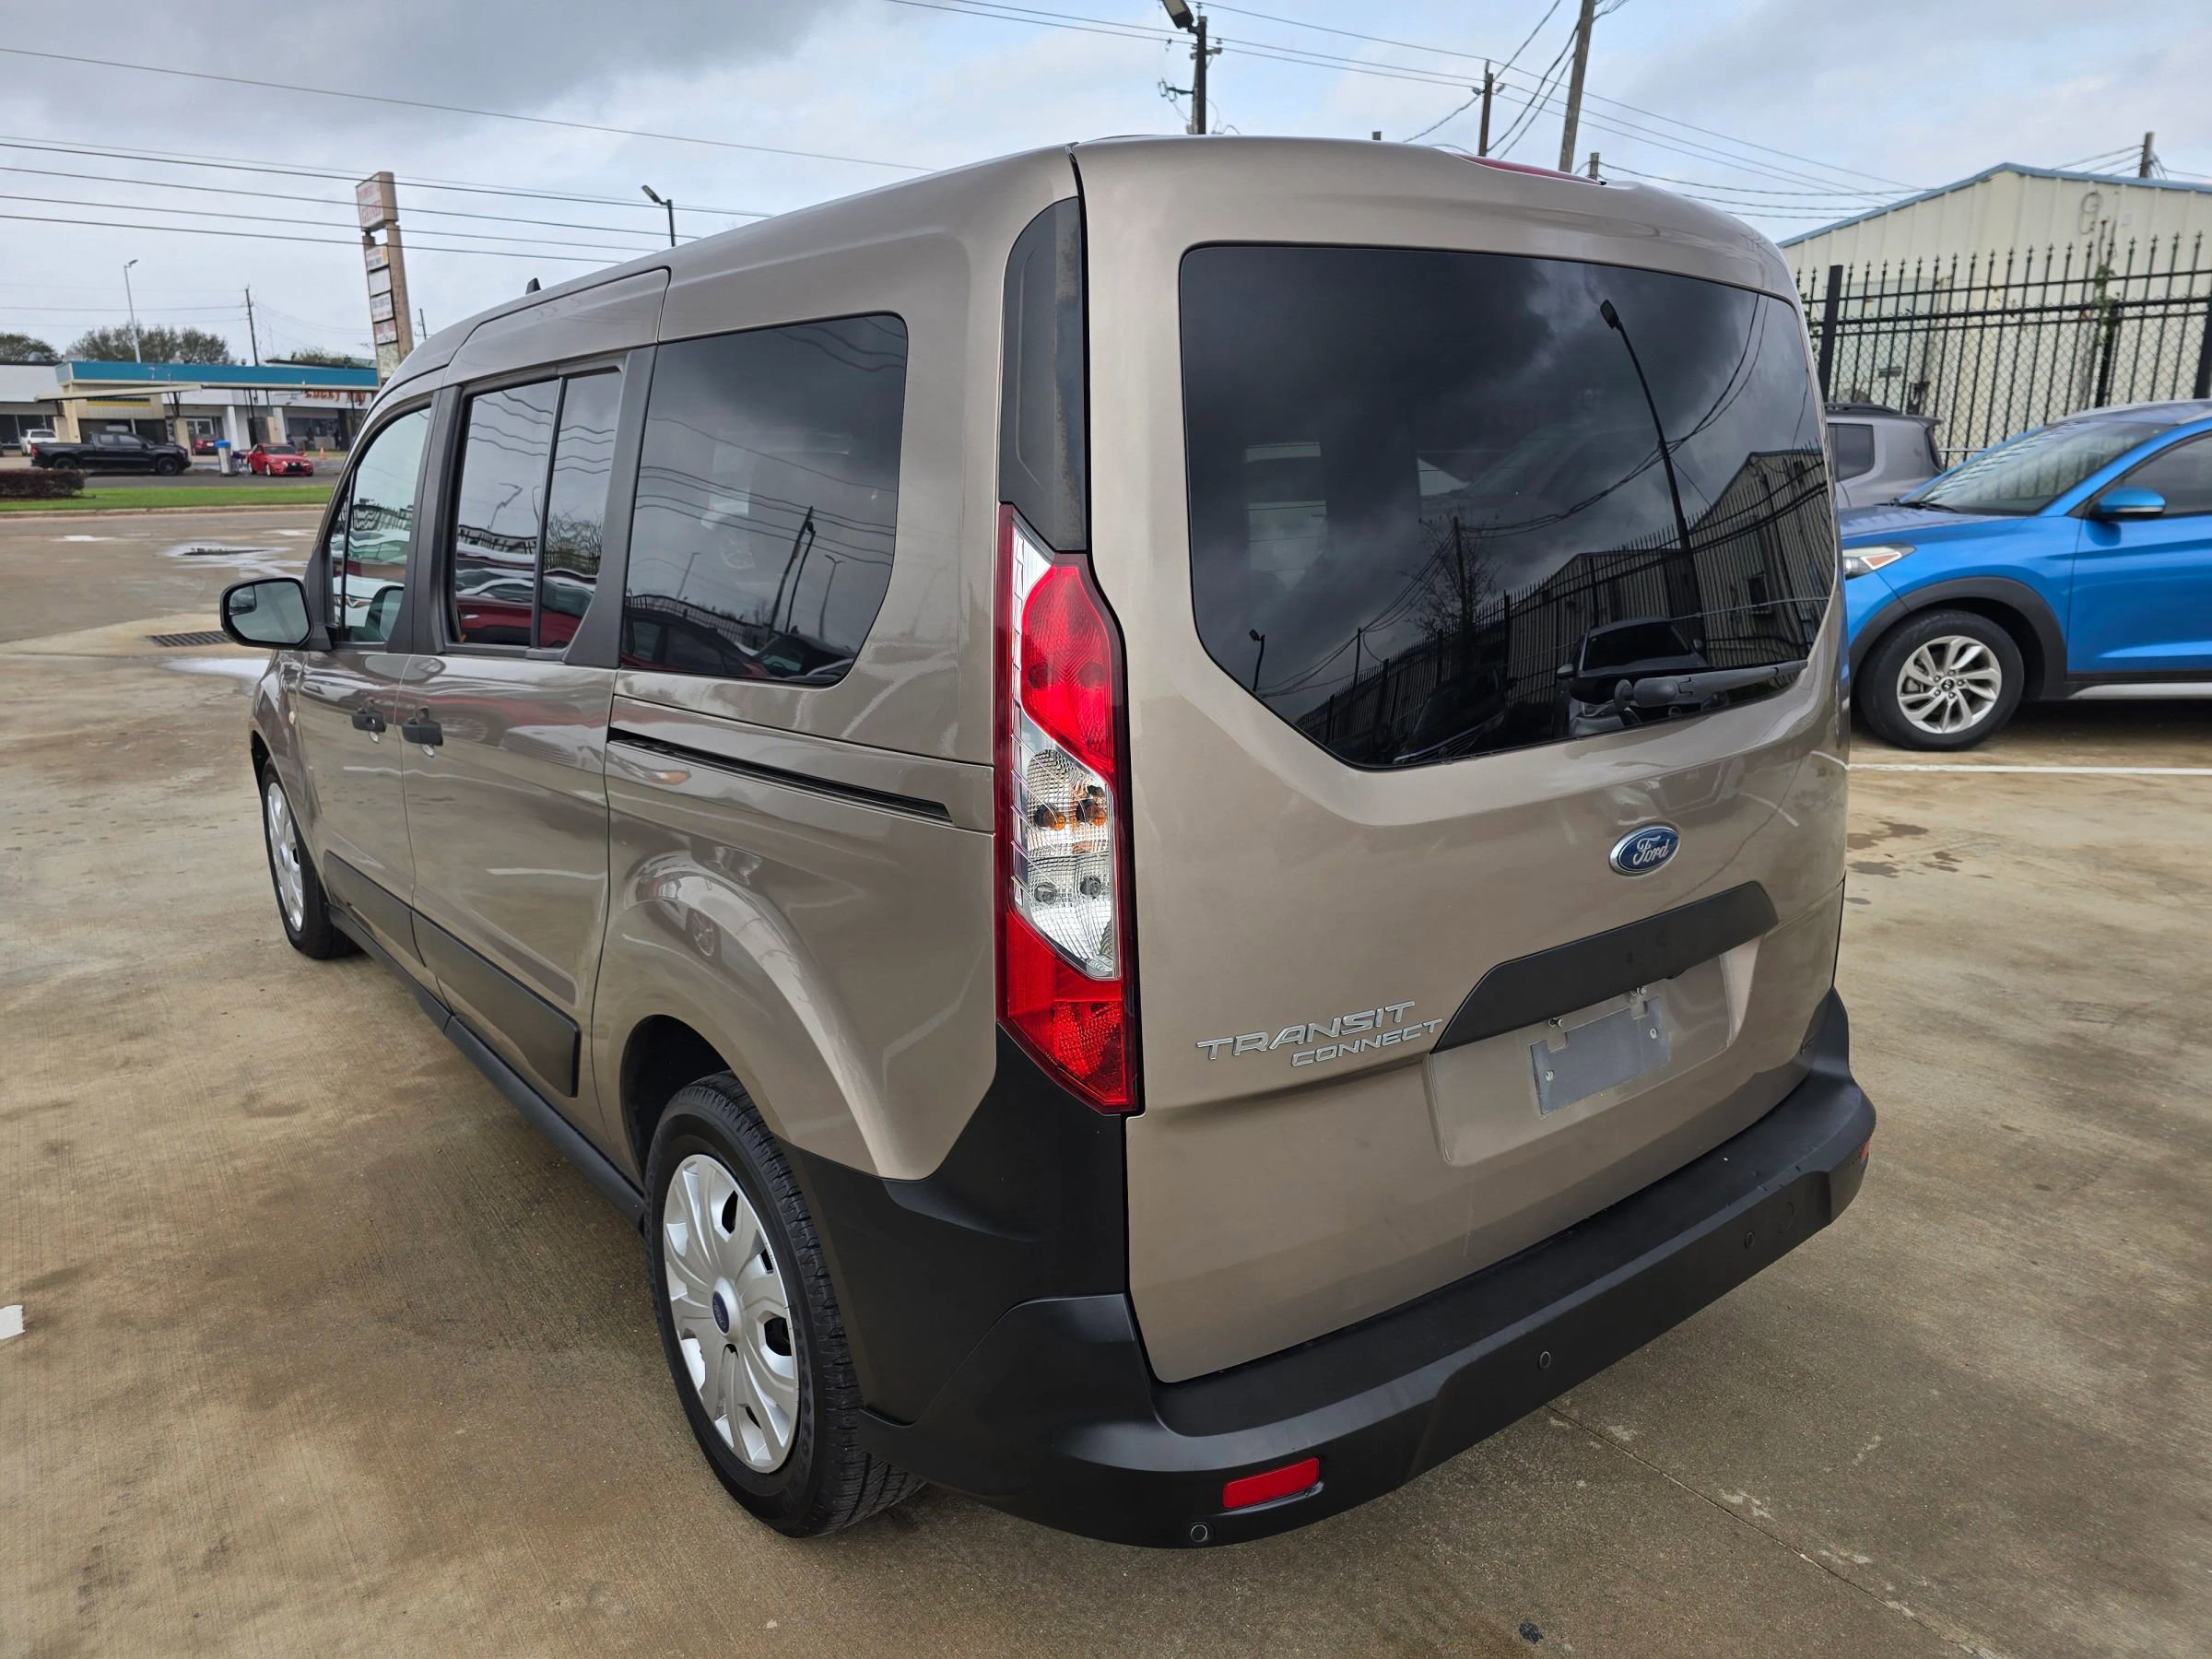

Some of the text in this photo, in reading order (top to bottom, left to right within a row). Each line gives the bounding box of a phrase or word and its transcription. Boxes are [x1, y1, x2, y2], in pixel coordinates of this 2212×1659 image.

[1632, 835, 1670, 865] Ford
[1196, 1001, 1416, 1061] TRANSIT
[1291, 1018, 1443, 1067] CONNECT
